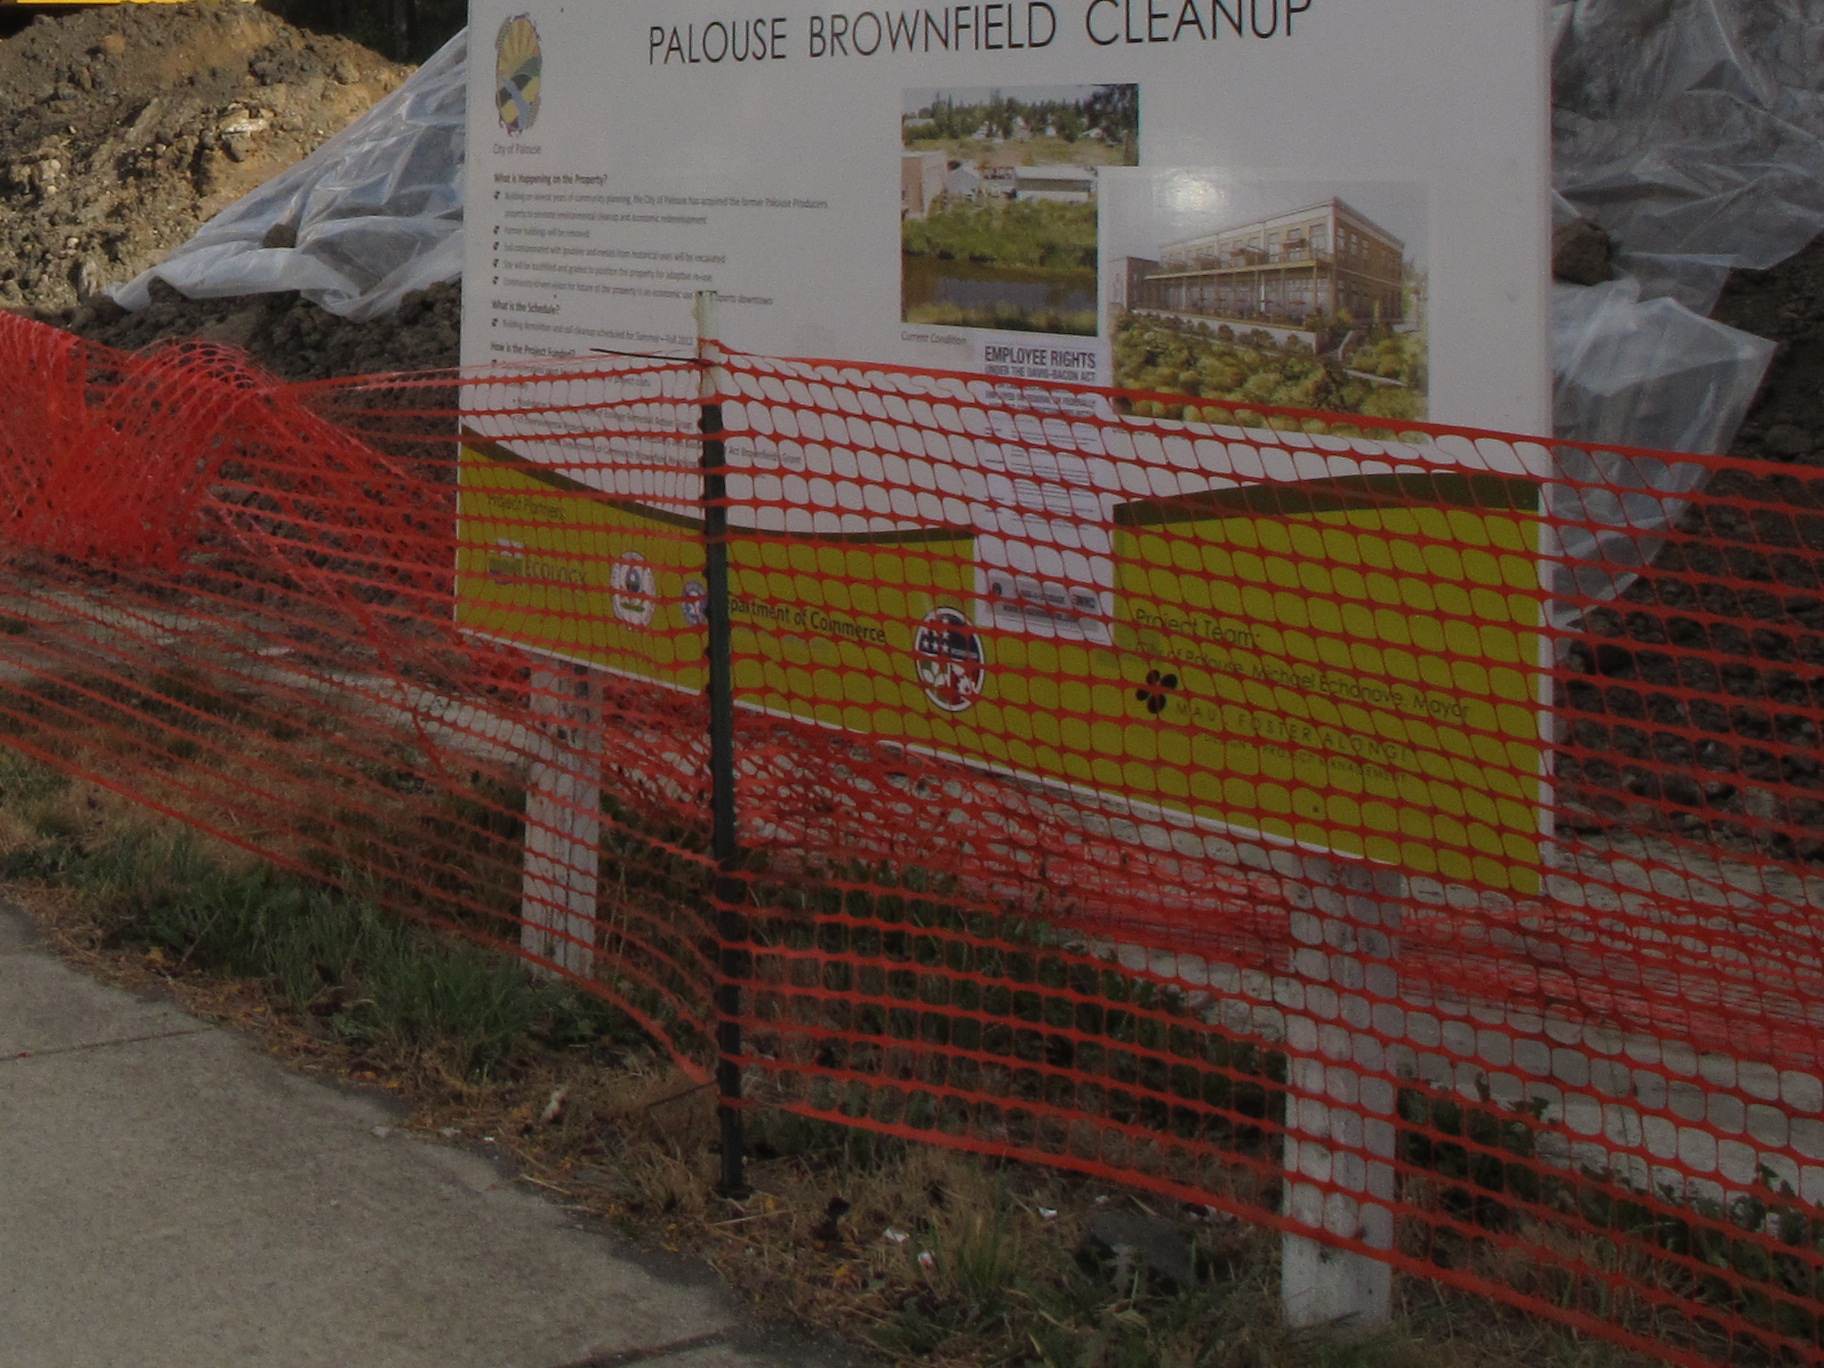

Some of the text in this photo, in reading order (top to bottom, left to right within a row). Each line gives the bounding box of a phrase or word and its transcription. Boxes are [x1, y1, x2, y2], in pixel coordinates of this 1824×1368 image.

[648, 18, 787, 65] PALOUSE
[809, 1, 1056, 57] BROWNFIELD
[984, 345, 1096, 369] EMPLOYEE RIGHTS
[727, 597, 790, 620] partment
[795, 609, 808, 627] of
[810, 611, 886, 644] Commerce
[1178, 702, 1223, 724] MAU
[1413, 694, 1469, 719] Mayor
